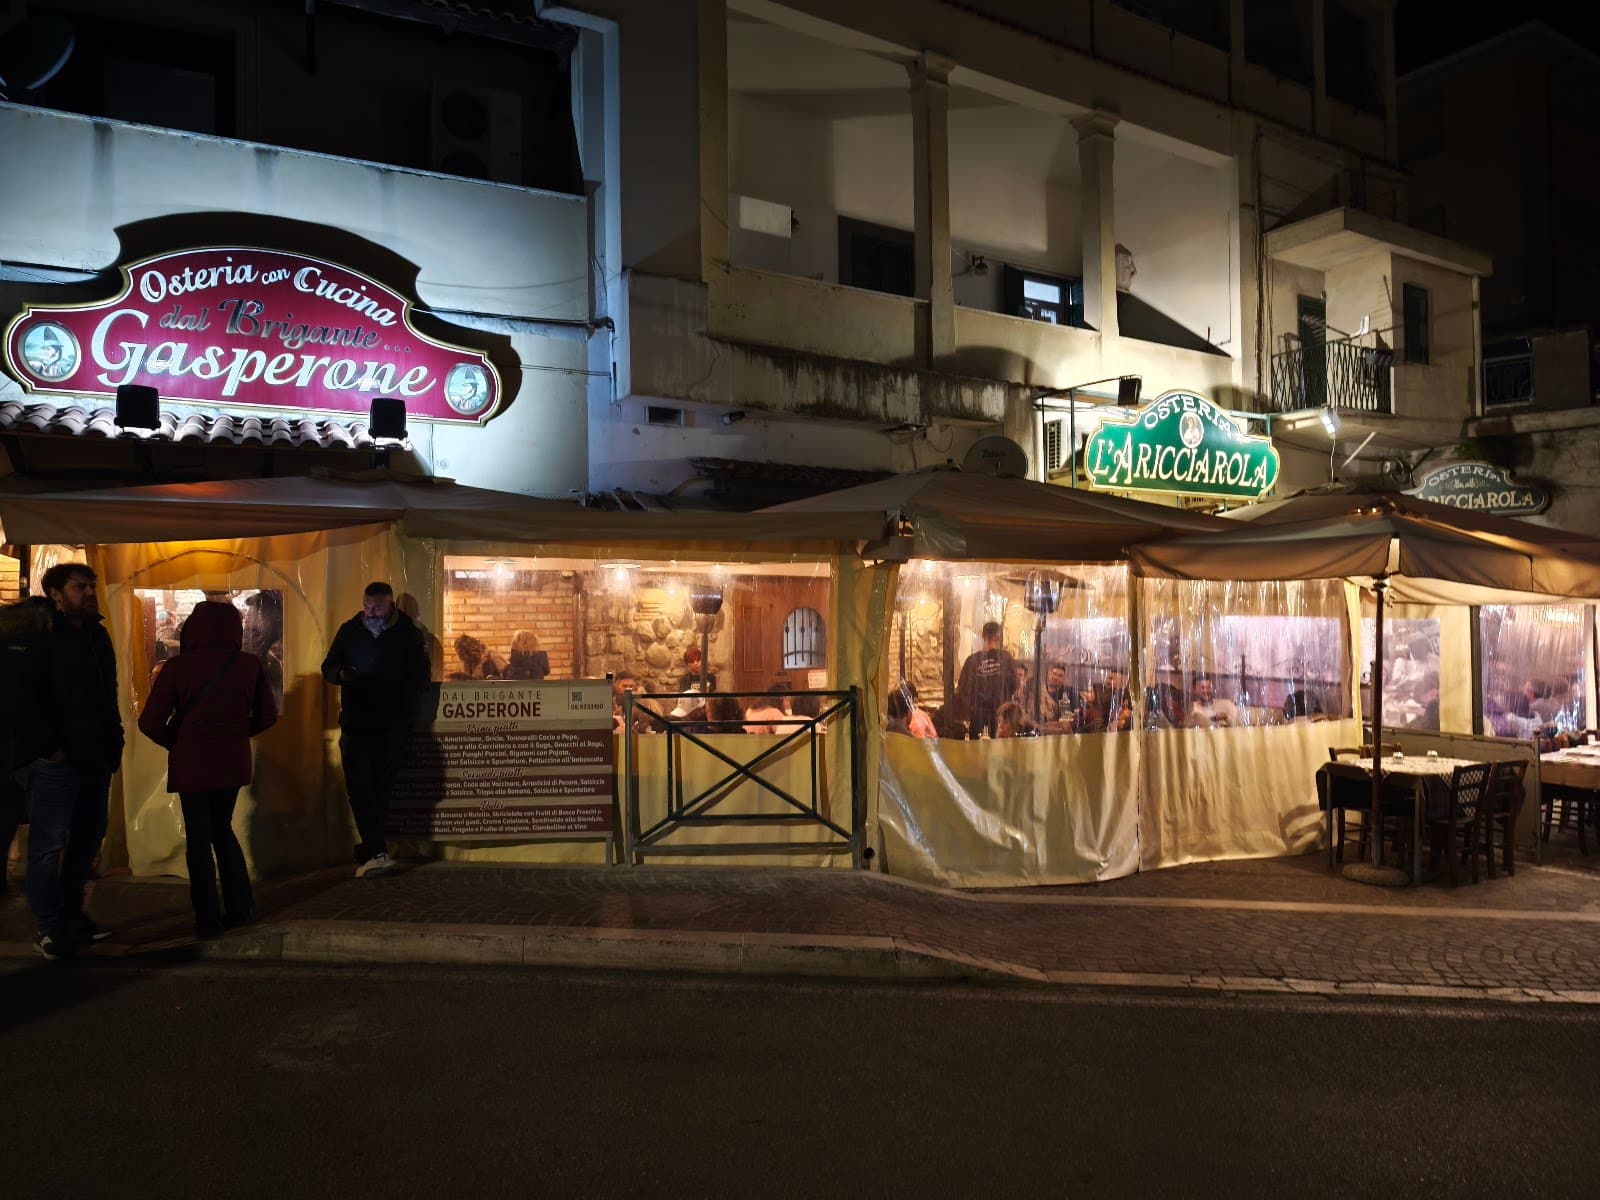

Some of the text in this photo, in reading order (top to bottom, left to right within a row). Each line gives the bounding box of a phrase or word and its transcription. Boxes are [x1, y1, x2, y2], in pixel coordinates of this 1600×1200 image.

[140, 257, 398, 327] Osteria con Cucina
[159, 304, 211, 331] dal
[90, 308, 436, 397] Gasperone
[1144, 396, 1232, 438] OSTERIA
[1093, 432, 1267, 488] L'ARICCIAROLA
[1428, 466, 1501, 486] OSTERIA
[442, 689, 542, 701] DAL BRIGANTE
[442, 702, 542, 718] GASPERONE
[554, 741, 579, 749] Gnocchi
